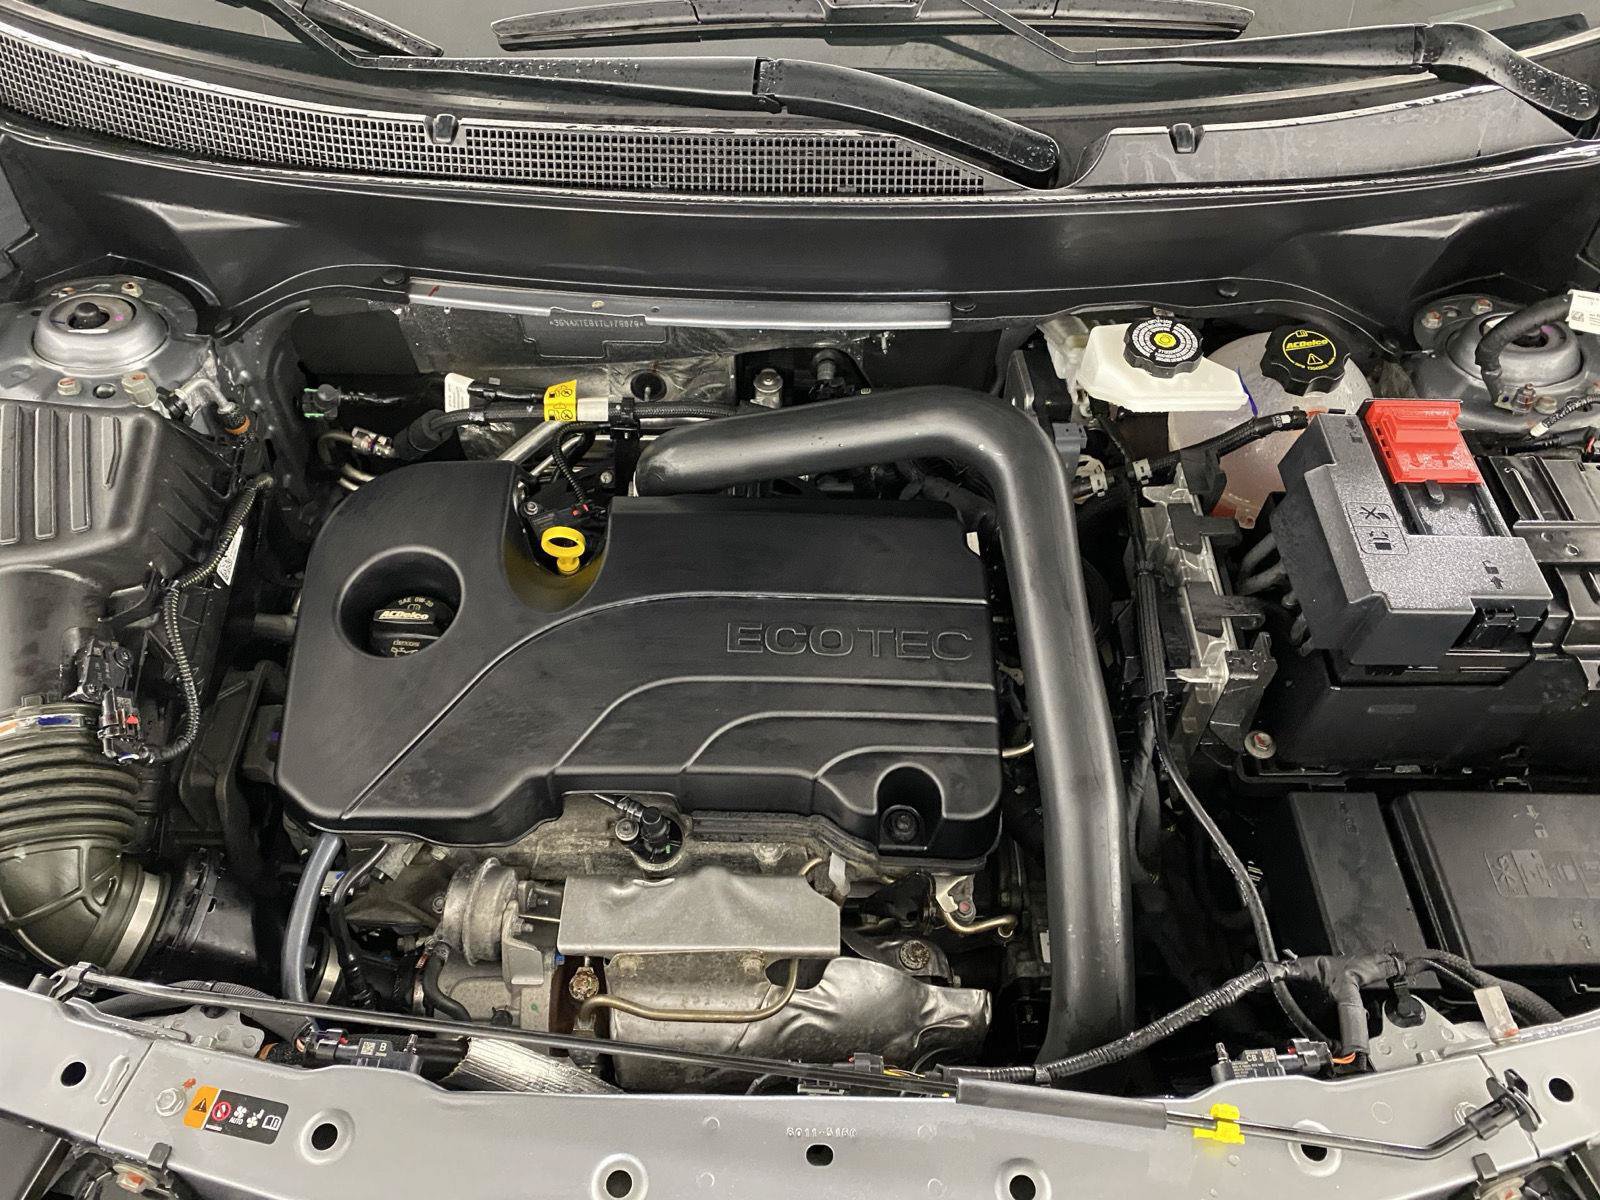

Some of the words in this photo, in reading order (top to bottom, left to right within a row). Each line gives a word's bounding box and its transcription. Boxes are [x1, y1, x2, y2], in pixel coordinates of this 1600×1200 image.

[1286, 339, 1329, 350] ACDelco
[379, 611, 429, 620] ACDelco
[727, 622, 972, 661] ECOTEC
[1246, 1054, 1258, 1062] CB
